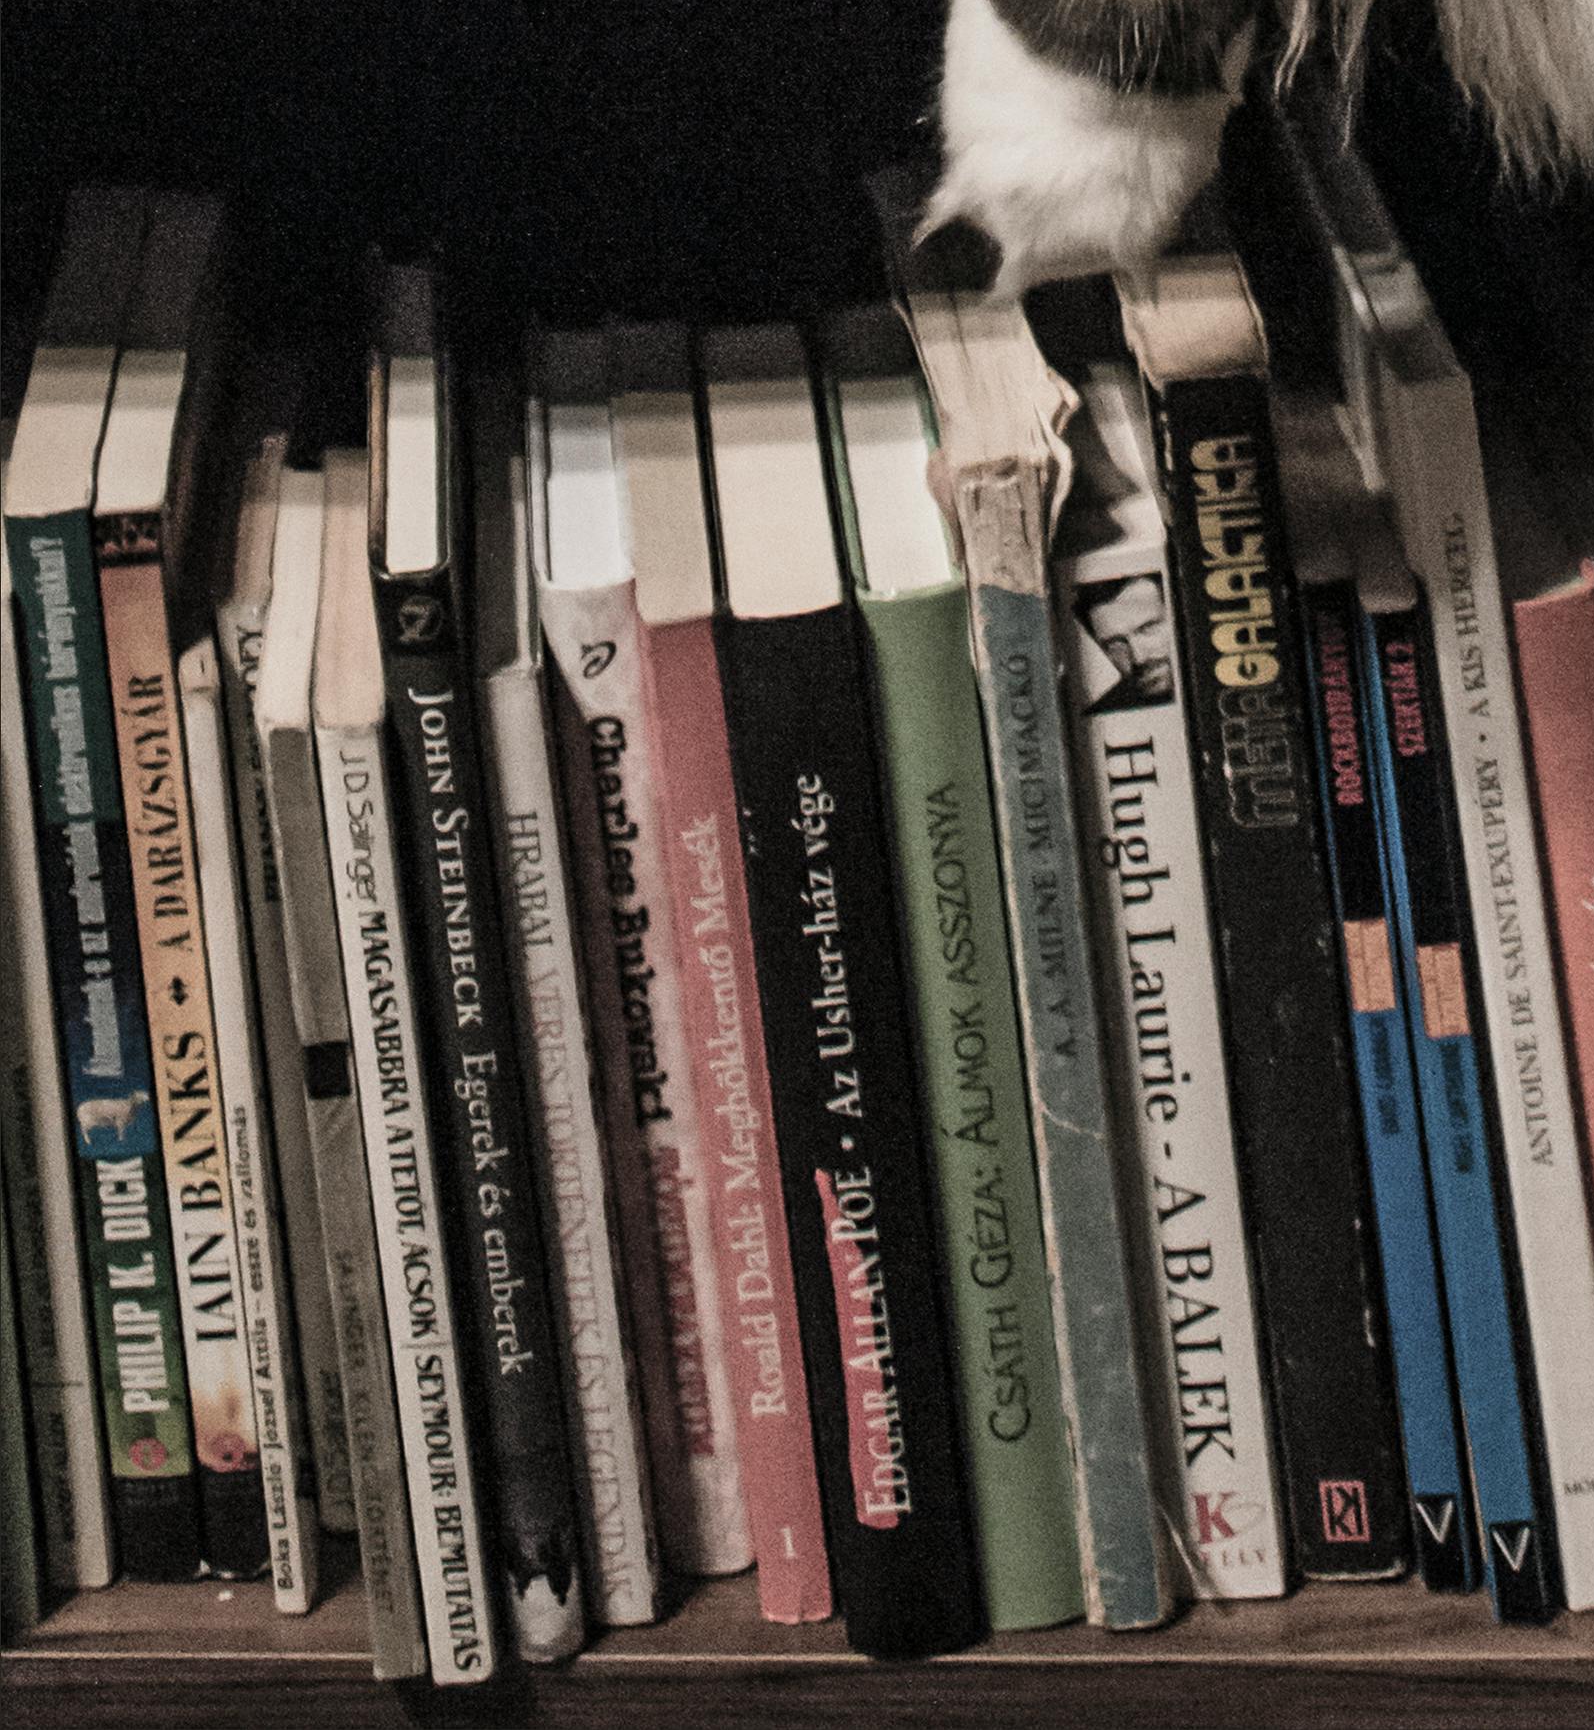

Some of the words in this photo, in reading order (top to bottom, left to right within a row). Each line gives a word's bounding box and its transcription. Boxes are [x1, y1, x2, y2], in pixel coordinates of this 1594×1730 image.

[1445, 510, 1479, 637] HERCEG
[1461, 646, 1487, 691] KIS
[1465, 697, 1492, 720] A
[120, 672, 190, 921] DARÁZSGYÁR
[407, 687, 457, 796] JOHN
[588, 715, 638, 898] Charles
[790, 772, 835, 858] vége
[1102, 734, 1173, 920] Hugh
[1473, 755, 1530, 983] SAINT-EXUPÉRY
[430, 806, 485, 1027] STEINBECK
[679, 810, 728, 939] Mesék
[923, 780, 981, 986] ASSZONYA
[155, 929, 194, 955] A
[798, 867, 856, 1060] Usher-ház
[608, 905, 674, 1130] Bukowski
[696, 944, 763, 1192] Meghökkentő
[1122, 926, 1194, 1125] Laurie
[1504, 988, 1535, 1028] DE
[159, 1030, 224, 1214] BANKS
[454, 1050, 510, 1173] Egerek
[823, 1070, 863, 1119] Az
[937, 1005, 1001, 1152] ÁLMOK
[1512, 1033, 1555, 1169] ANTOINE
[94, 1156, 152, 1242] DICK
[475, 1183, 504, 1219] és
[731, 1202, 774, 1302] Dahl:
[829, 1166, 880, 1244] POE
[960, 1167, 1015, 1292] GÉZA:
[1152, 1174, 1209, 1226] A
[107, 1251, 159, 1290] K.
[184, 1234, 236, 1343] IAIN
[484, 1226, 533, 1377] emberek
[847, 1251, 897, 1379] ALLAN
[111, 1300, 172, 1414] PHILIP
[747, 1313, 791, 1419] Roald
[979, 1302, 1032, 1447] CSÁTH
[1159, 1238, 1238, 1470] BALEK
[861, 1385, 914, 1517] EDGAR
